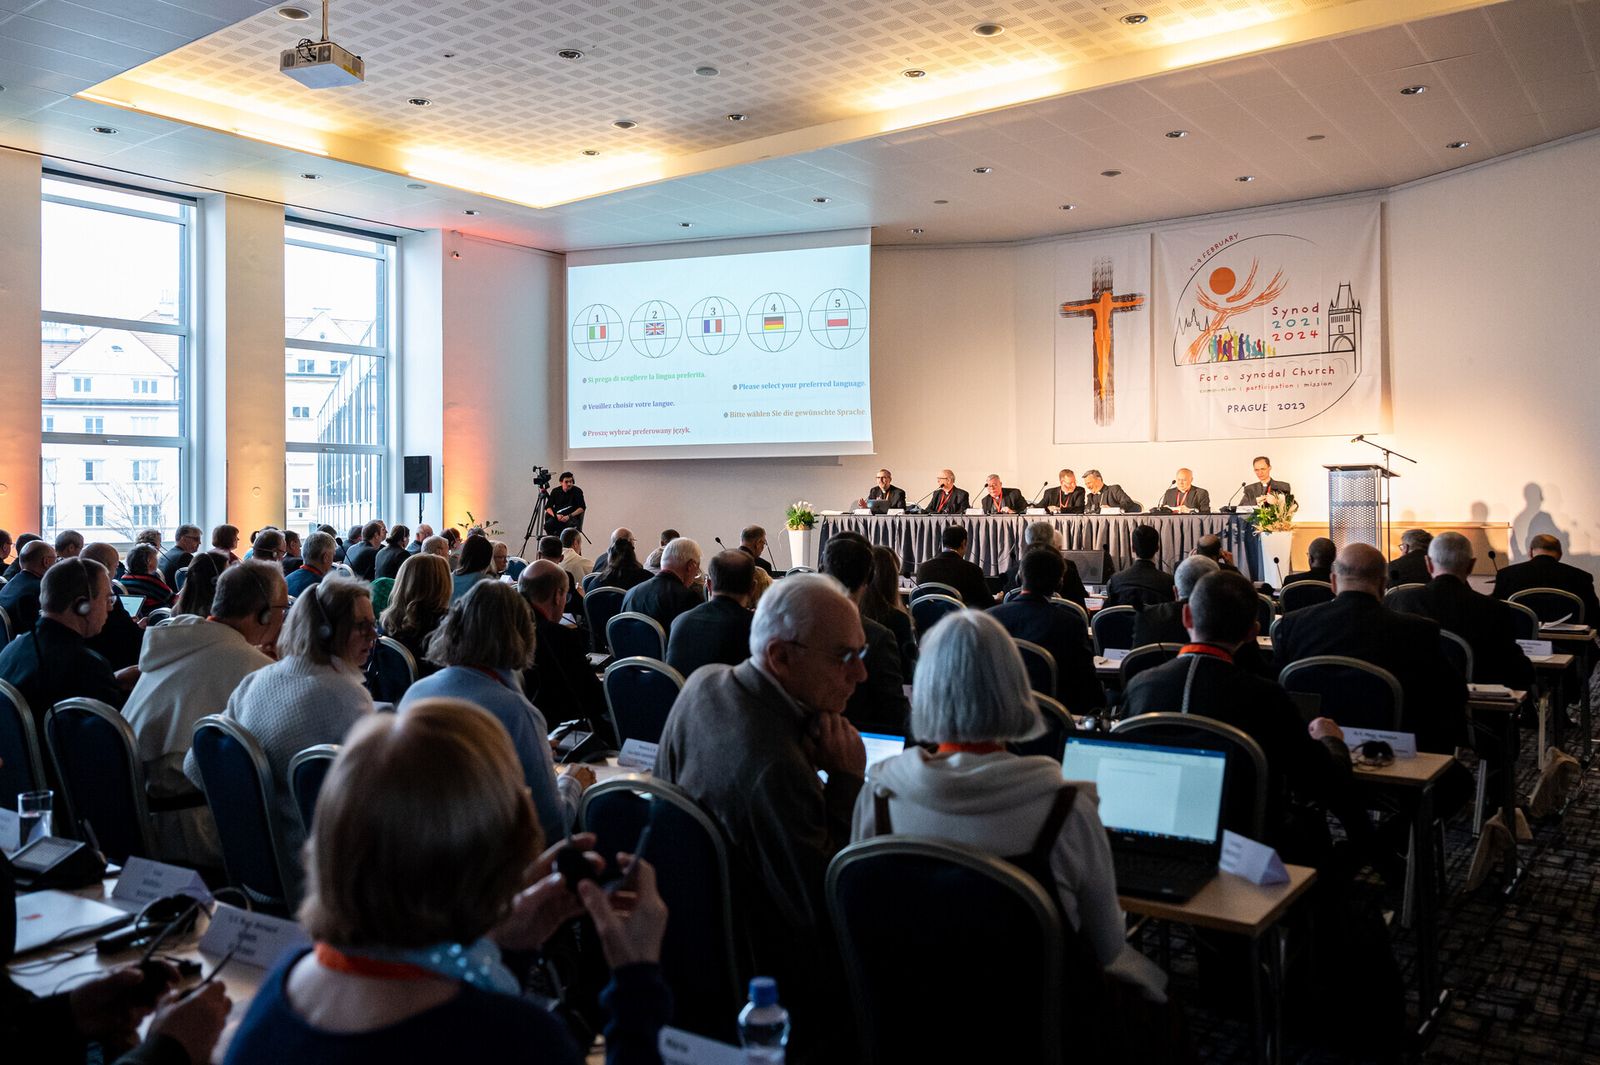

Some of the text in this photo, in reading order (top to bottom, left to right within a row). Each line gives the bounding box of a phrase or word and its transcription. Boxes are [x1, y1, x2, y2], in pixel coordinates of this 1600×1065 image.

[1202, 232, 1239, 259] FEBRUARY
[770, 303, 777, 312] 4
[834, 299, 841, 308] 5
[652, 310, 658, 319] 2
[710, 307, 716, 316] 3
[1272, 302, 1319, 320] Synod
[595, 314, 600, 323] 1
[1272, 317, 1319, 329] 2021
[1272, 330, 1319, 342] 2024
[655, 373, 676, 381] lingua
[1199, 373, 1218, 382] For
[1240, 369, 1286, 382] synodal
[1292, 365, 1335, 376] Church
[781, 381, 797, 390] your
[798, 380, 832, 389] preferred
[652, 400, 675, 408] langue.
[1227, 402, 1306, 413] PRAGUE 2023
[771, 409, 782, 417] Sie
[794, 408, 836, 417] gewünschte
